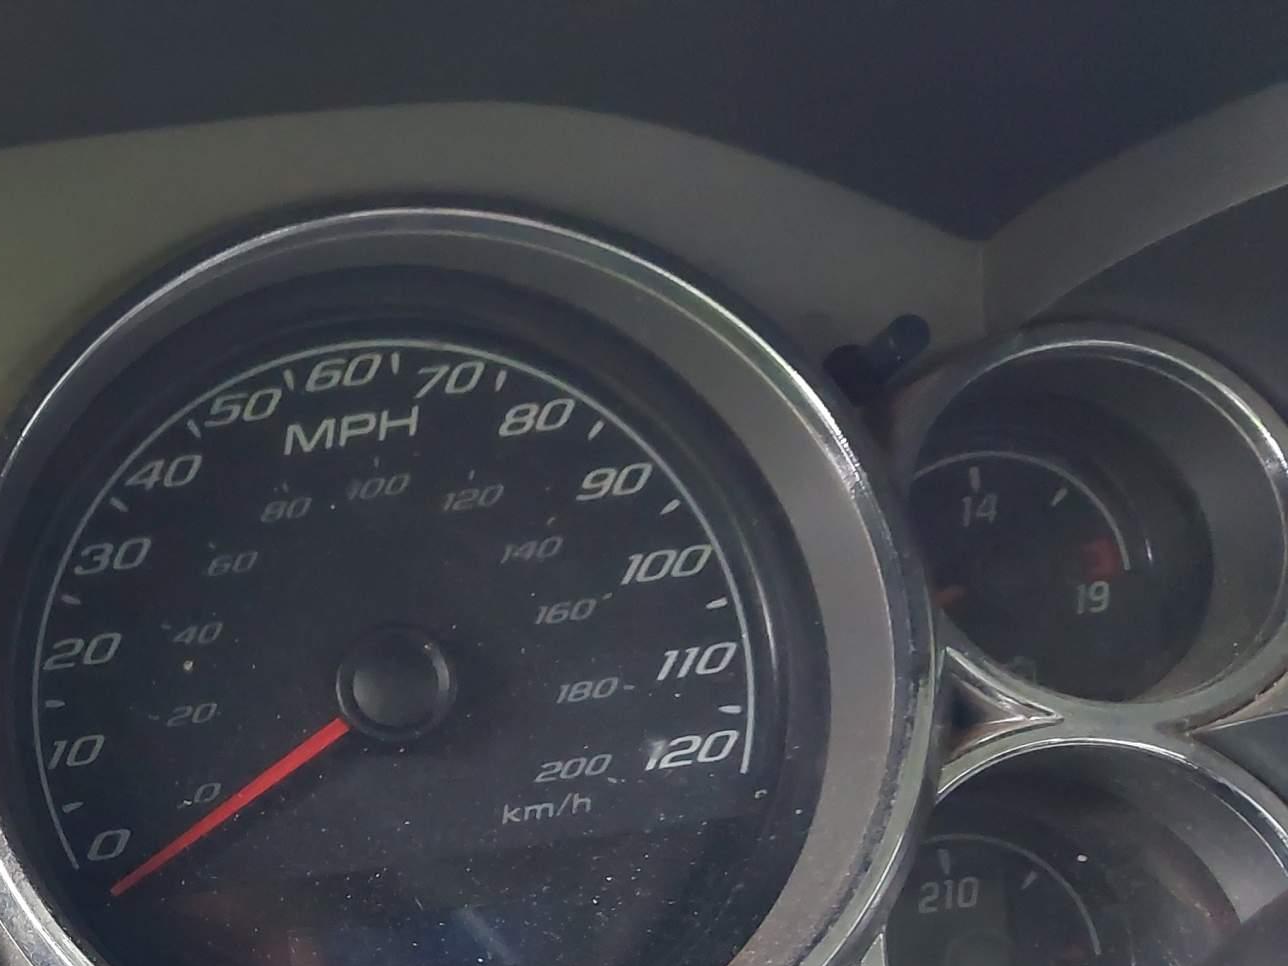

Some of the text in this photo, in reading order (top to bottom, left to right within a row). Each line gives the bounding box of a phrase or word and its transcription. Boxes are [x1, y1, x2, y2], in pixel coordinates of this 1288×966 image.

[306, 353, 383, 390] 60
[415, 361, 484, 398] 70
[204, 388, 282, 426] 50
[499, 399, 574, 436] 80
[284, 406, 420, 456] MPH
[126, 454, 202, 489] 40
[575, 462, 652, 501] 90
[260, 495, 312, 523] 80
[442, 484, 504, 511] 120
[962, 494, 997, 526] 14
[74, 537, 151, 575] 30
[500, 536, 563, 564] 140
[621, 543, 711, 584] 100
[535, 599, 595, 624] 160
[1077, 581, 1110, 614] 19
[43, 632, 122, 670] 20
[172, 622, 223, 645] 40
[656, 641, 737, 679] 110
[557, 678, 617, 703] 180
[167, 704, 217, 727] 20
[49, 734, 104, 770] 10
[645, 730, 739, 770] 120
[534, 754, 612, 782] 200
[502, 795, 591, 825] km/h
[87, 829, 131, 861] 0
[918, 877, 979, 913] 210
